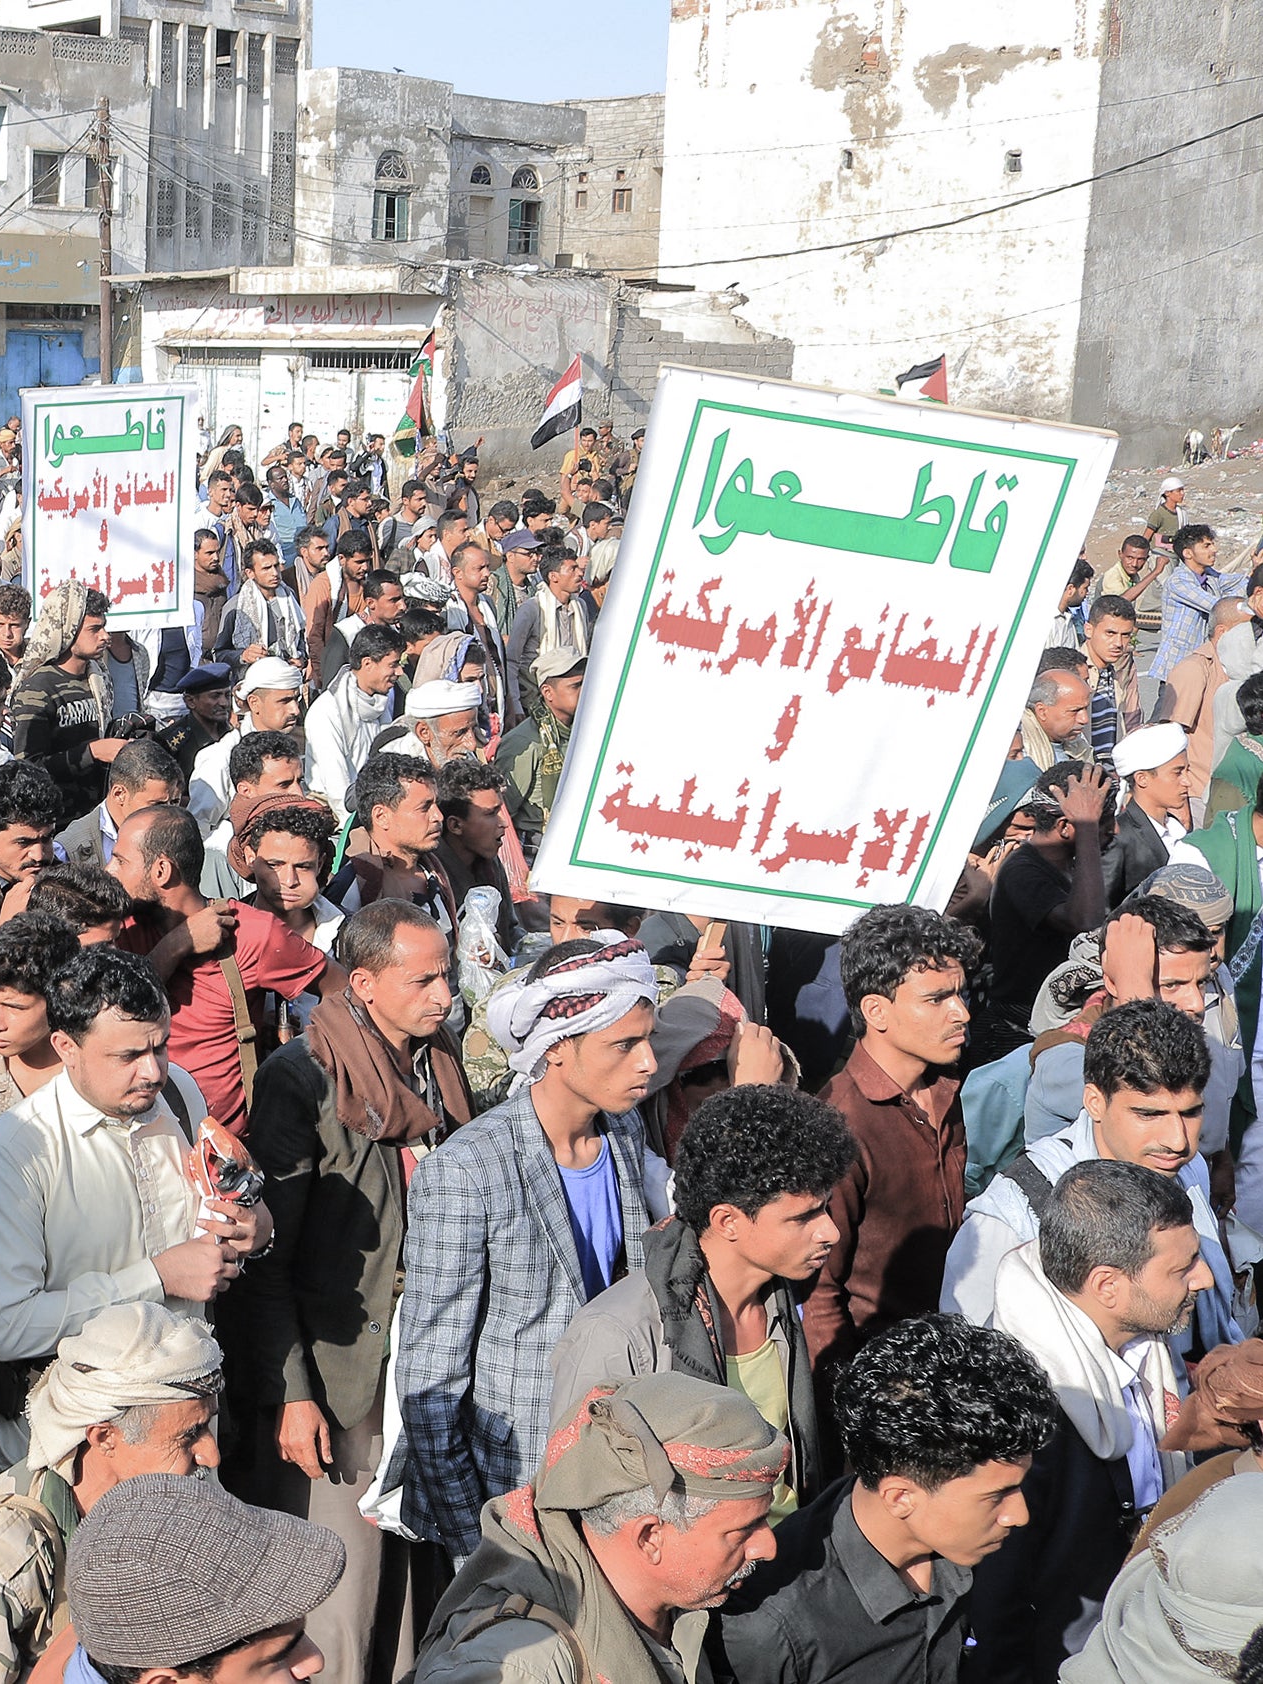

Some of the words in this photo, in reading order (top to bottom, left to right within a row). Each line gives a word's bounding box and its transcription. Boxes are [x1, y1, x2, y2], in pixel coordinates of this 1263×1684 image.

[44, 408, 165, 468] قاطعوا
[37, 467, 108, 520] الأمريكية
[113, 470, 175, 516] البضائع
[692, 428, 1020, 574] قاطعوا
[98, 518, 108, 552] و
[646, 568, 833, 676] الأمريكية
[826, 602, 999, 708] البضائع
[764, 694, 802, 763] و
[598, 760, 931, 889] الإسرائيلية
